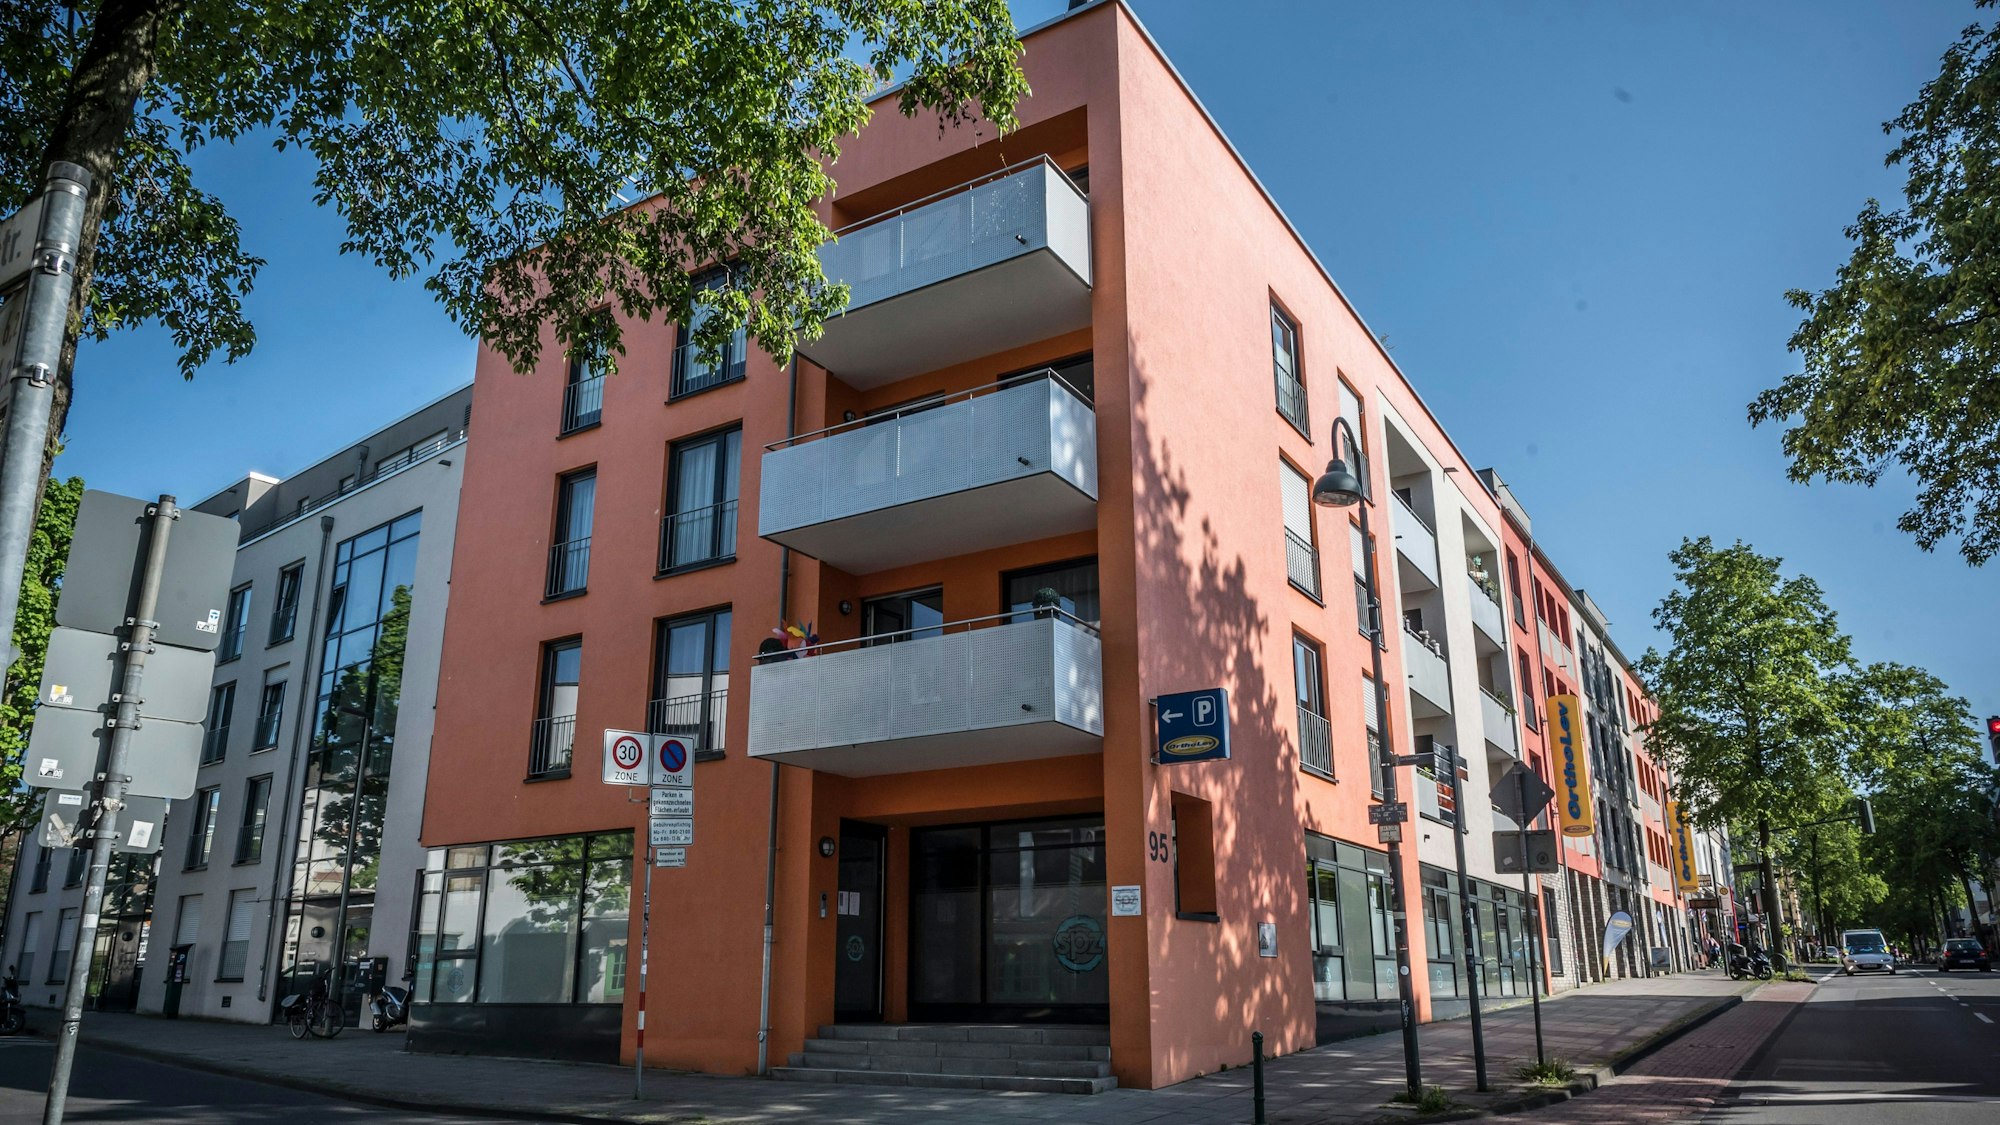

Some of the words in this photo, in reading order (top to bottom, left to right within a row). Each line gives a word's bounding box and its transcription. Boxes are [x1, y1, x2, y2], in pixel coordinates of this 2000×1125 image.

[0, 229, 21, 266] tr.
[1198, 700, 1212, 722] P
[619, 745, 636, 761] 30
[1168, 738, 1214, 750] OrthoLev
[1558, 701, 1581, 819] OrthoLev
[615, 771, 638, 781] ZONE
[662, 774, 683, 783] ZONE
[1149, 831, 1168, 863] 95
[1676, 804, 1691, 881] OrthoL
[1115, 895, 1138, 908] spz
[1056, 930, 1104, 961] spz
